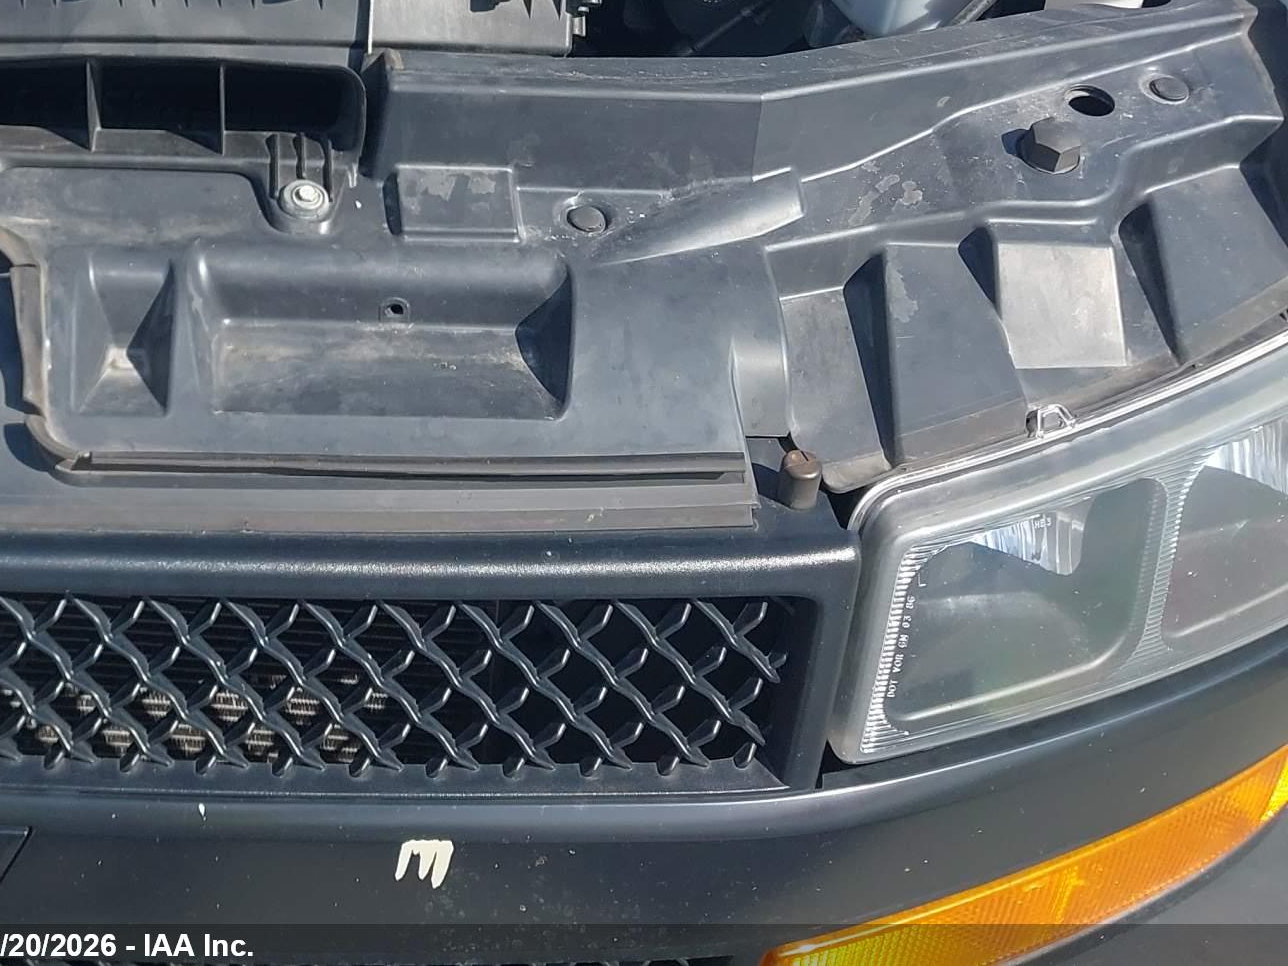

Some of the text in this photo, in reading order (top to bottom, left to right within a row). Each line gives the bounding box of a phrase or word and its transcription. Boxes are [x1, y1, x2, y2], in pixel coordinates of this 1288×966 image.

[901, 615, 912, 629] 03
[892, 654, 905, 674] VOR
[886, 680, 900, 698] DOT
